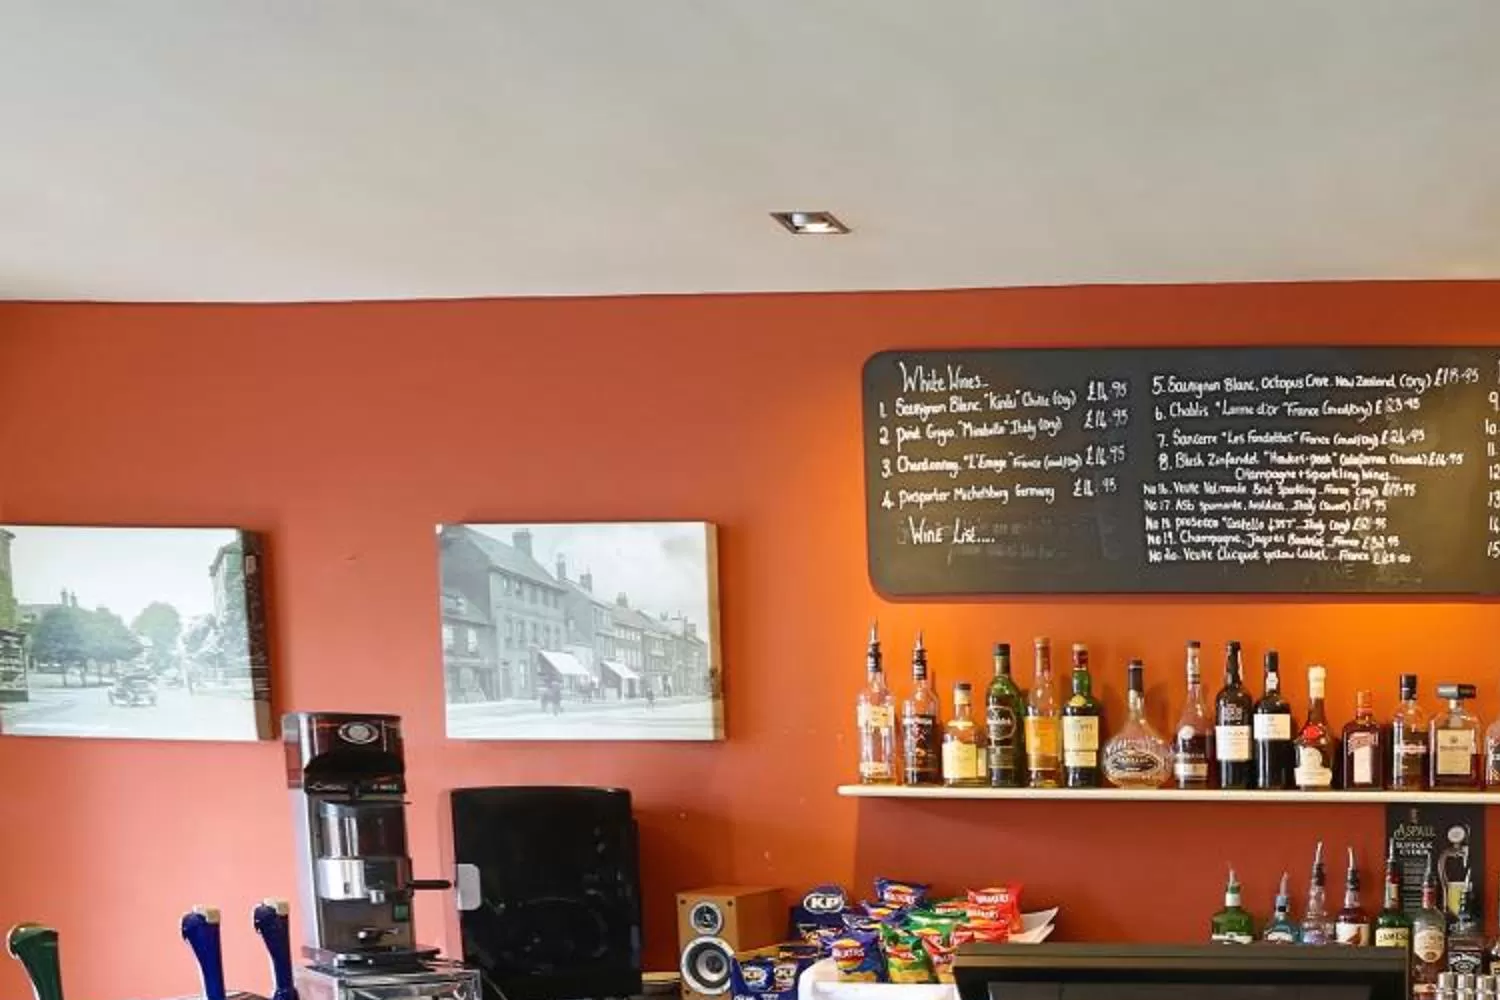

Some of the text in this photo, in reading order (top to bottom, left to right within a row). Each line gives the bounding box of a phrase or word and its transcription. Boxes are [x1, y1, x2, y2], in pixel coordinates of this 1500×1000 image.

[899, 361, 946, 392] White
[1261, 374, 1304, 395] Octopus
[1169, 401, 1209, 417] Chablis
[811, 896, 841, 909] KP
